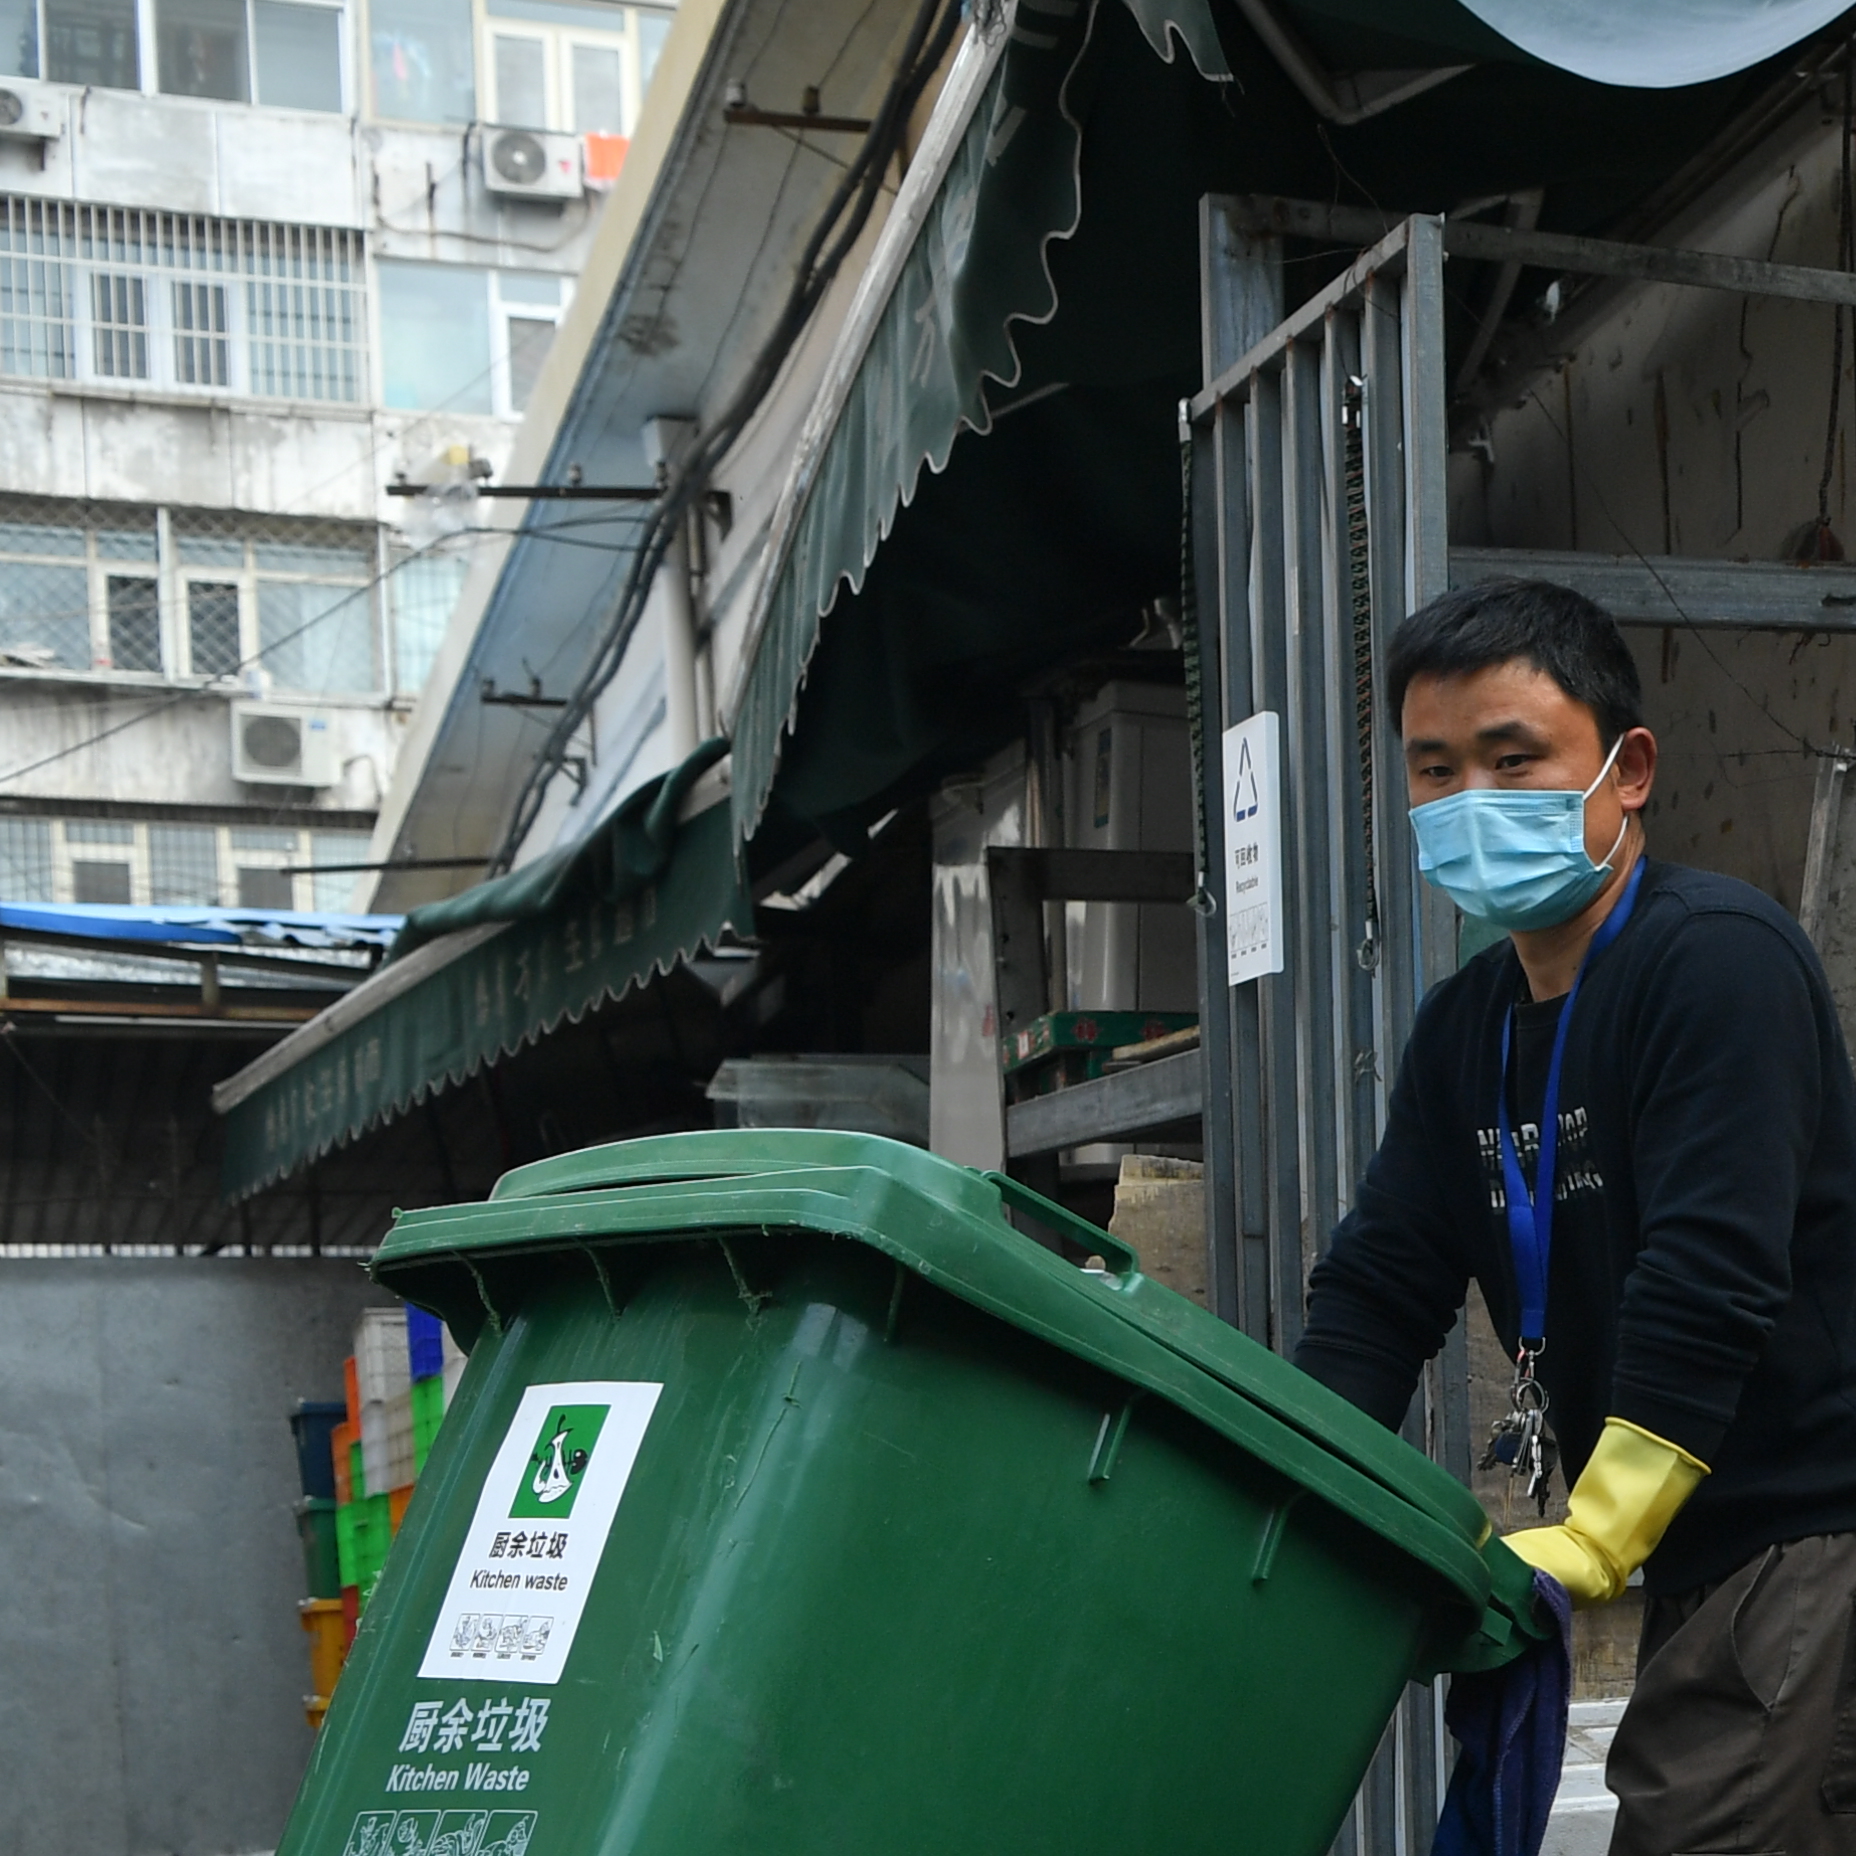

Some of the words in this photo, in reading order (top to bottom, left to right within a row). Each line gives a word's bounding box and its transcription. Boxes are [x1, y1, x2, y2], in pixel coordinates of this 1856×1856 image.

[488, 1530, 568, 1562] 厨余垃圾
[470, 1568, 521, 1591] Kitchen
[523, 1571, 569, 1592] waste
[399, 1698, 551, 1755] 厨余垃圾
[386, 1763, 459, 1794] Kitchen
[464, 1763, 530, 1794] Waste
